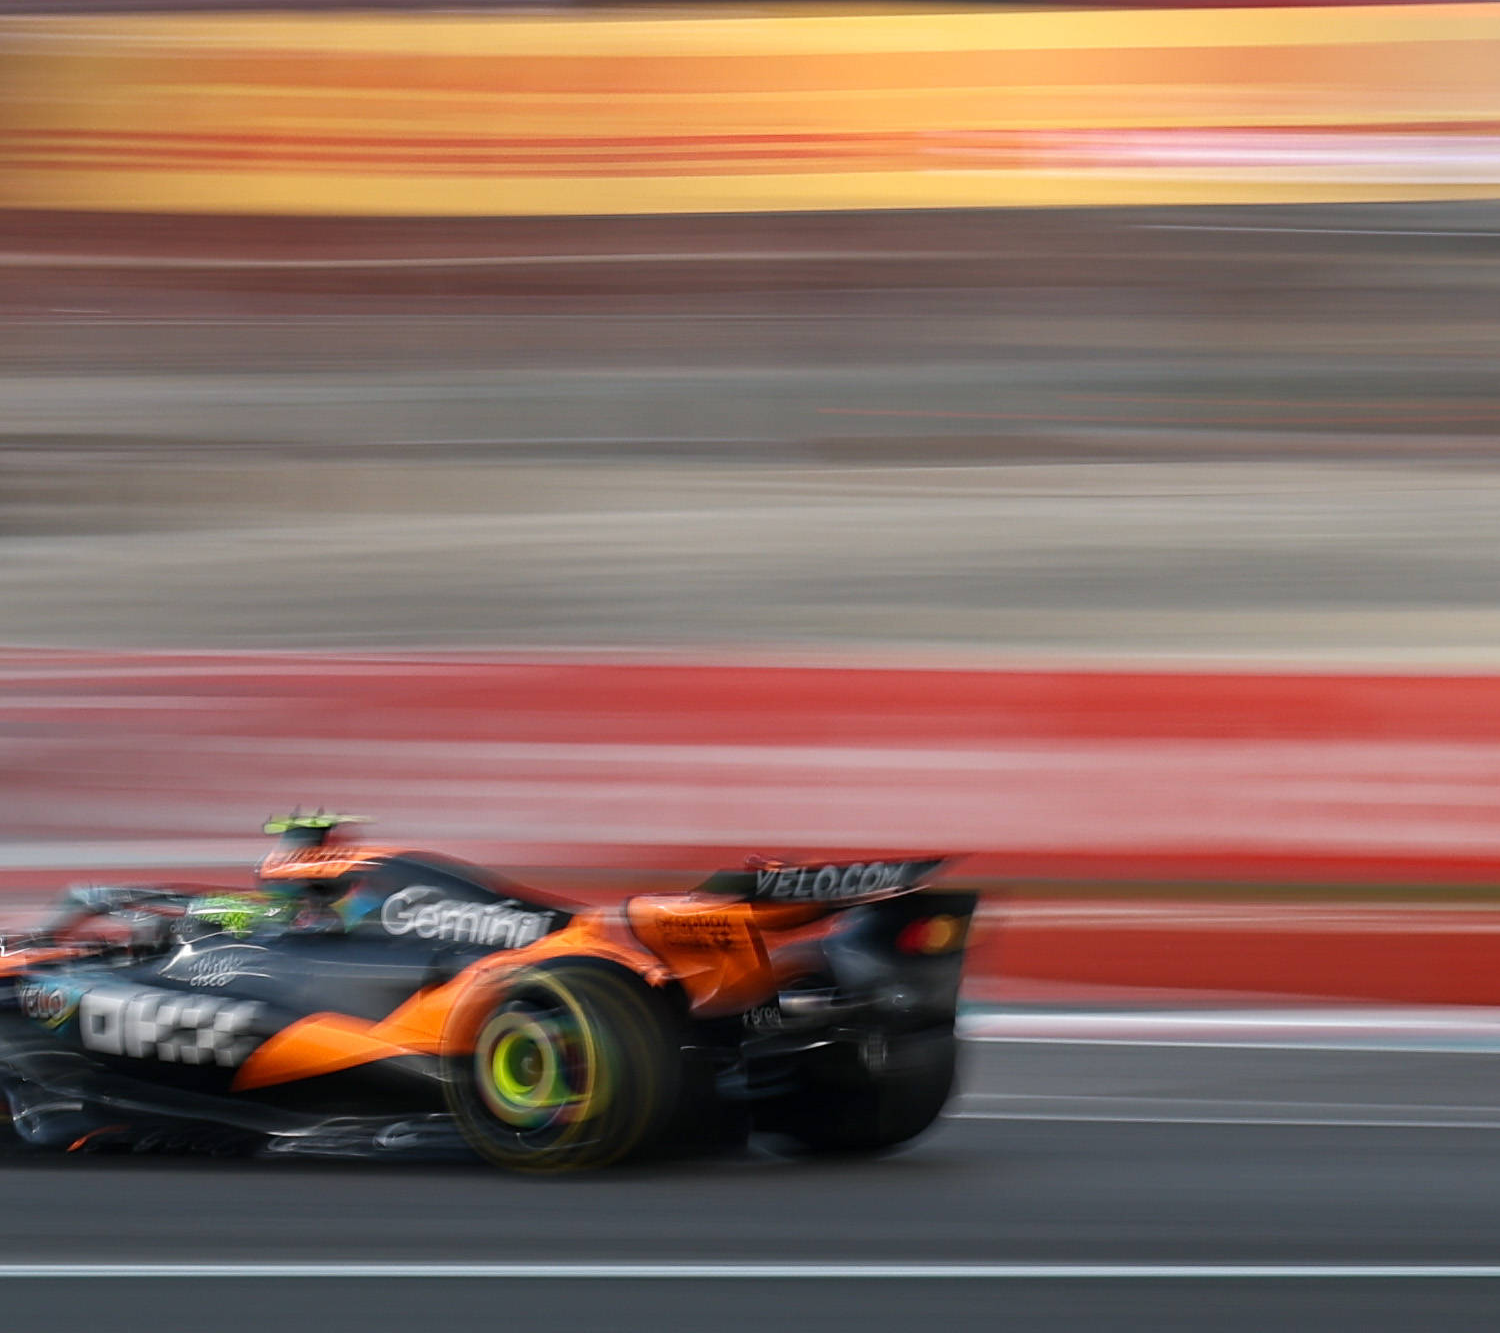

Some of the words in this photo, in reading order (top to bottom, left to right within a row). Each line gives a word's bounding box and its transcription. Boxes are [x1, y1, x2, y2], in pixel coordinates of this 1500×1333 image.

[756, 862, 904, 898] VELO.COM
[381, 885, 556, 949] Gemini
[190, 973, 229, 988] cisco
